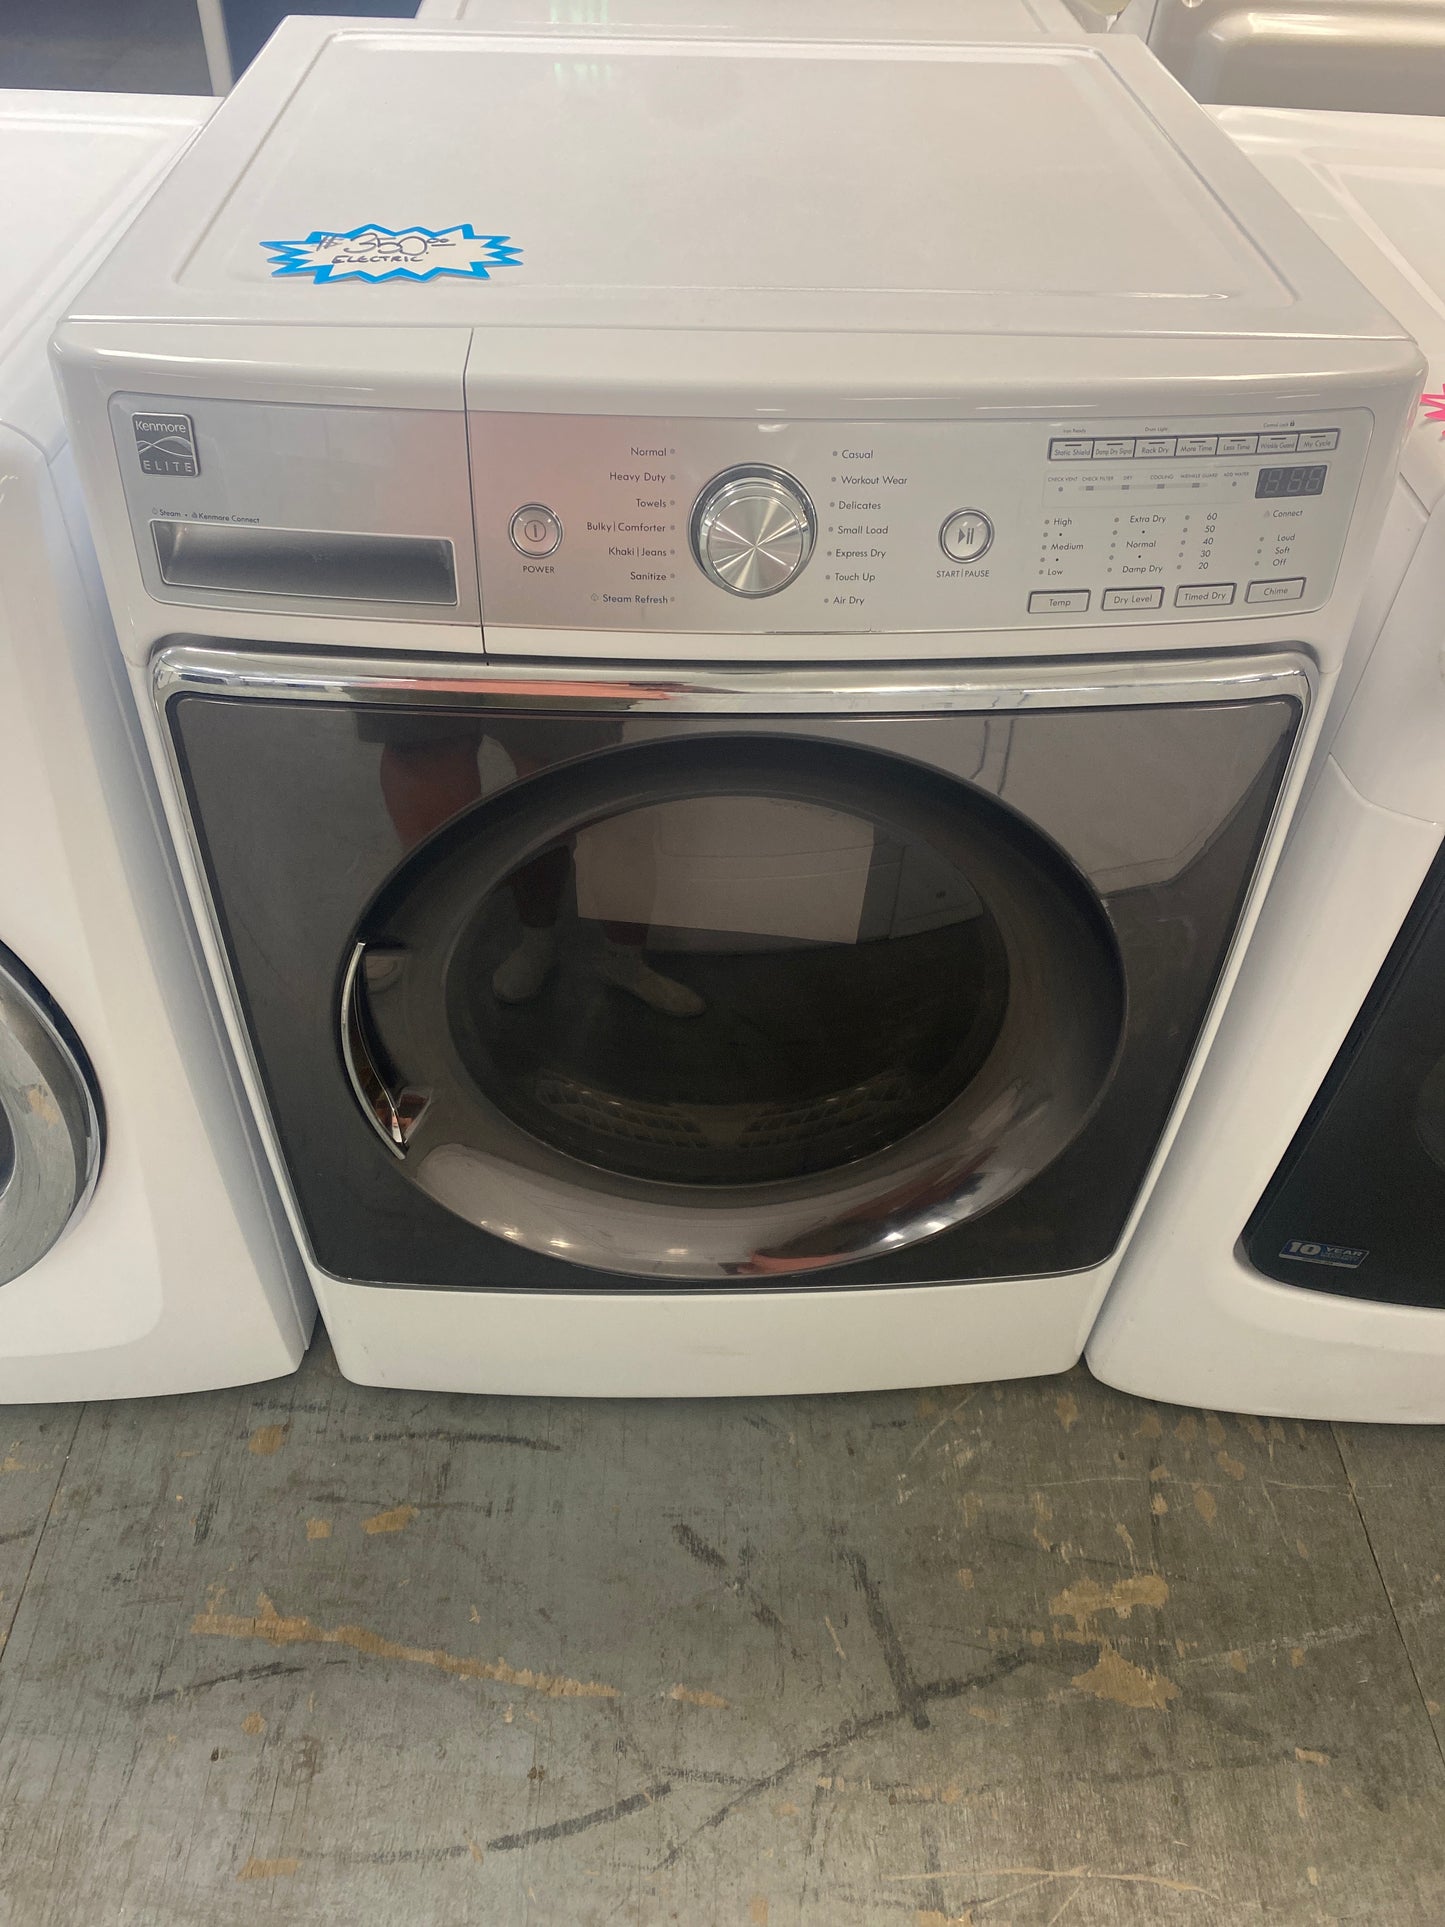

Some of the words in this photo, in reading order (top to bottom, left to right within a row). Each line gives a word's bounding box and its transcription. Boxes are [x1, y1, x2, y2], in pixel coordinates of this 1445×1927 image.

[331, 255, 424, 264] ELECTRIC
[135, 420, 186, 433] Kenmore
[1237, 443, 1250, 451] Time
[1315, 440, 1331, 448] Cycle
[631, 447, 667, 457] Normal
[842, 450, 874, 459] Casual
[1110, 448, 1118, 456] Dry
[143, 460, 192, 473] ELITE
[609, 472, 640, 482] Heavy
[644, 472, 666, 483] Duty
[841, 475, 879, 485] Workout
[882, 476, 908, 485] Wear
[636, 498, 667, 508] Towels
[838, 501, 881, 510] Delicates
[159, 509, 181, 518] Steam
[198, 511, 230, 521] Kenmore
[231, 515, 260, 524] Connect
[1206, 512, 1218, 521] 60
[1273, 509, 1303, 518] Connect
[1053, 517, 1073, 527] High
[1130, 515, 1151, 524] Extra
[1152, 515, 1167, 525] Dry
[837, 526, 863, 535] Small
[866, 526, 888, 535] Load
[1205, 525, 1216, 533] 50
[1202, 537, 1214, 546] 40
[1277, 533, 1296, 542] Loud
[1050, 542, 1084, 551] Medium
[1126, 540, 1157, 549] Normal
[836, 549, 868, 558] Express
[871, 549, 886, 559] Dry
[1200, 549, 1211, 558] 30
[1275, 546, 1291, 555] Soft
[1198, 562, 1209, 570] 20
[1273, 558, 1287, 567] Off
[522, 565, 555, 574] POWER
[1047, 567, 1063, 576] Low
[1122, 565, 1146, 575] Damp
[1149, 564, 1163, 574] Dry
[630, 571, 667, 581] Sanitize
[835, 572, 859, 581] Touch
[862, 572, 876, 582] Up
[1263, 586, 1288, 596] Chime
[603, 594, 632, 603] Steam
[635, 594, 668, 604] Refresh
[1114, 596, 1129, 606] Dry
[1131, 594, 1152, 604] Level
[1184, 592, 1208, 601] Timed
[1211, 591, 1227, 601] Dry
[833, 596, 846, 605] Air
[849, 596, 865, 606] Dry
[1049, 598, 1071, 608] Temp
[1289, 1241, 1321, 1256] 10
[1326, 1246, 1363, 1257] YEAR
